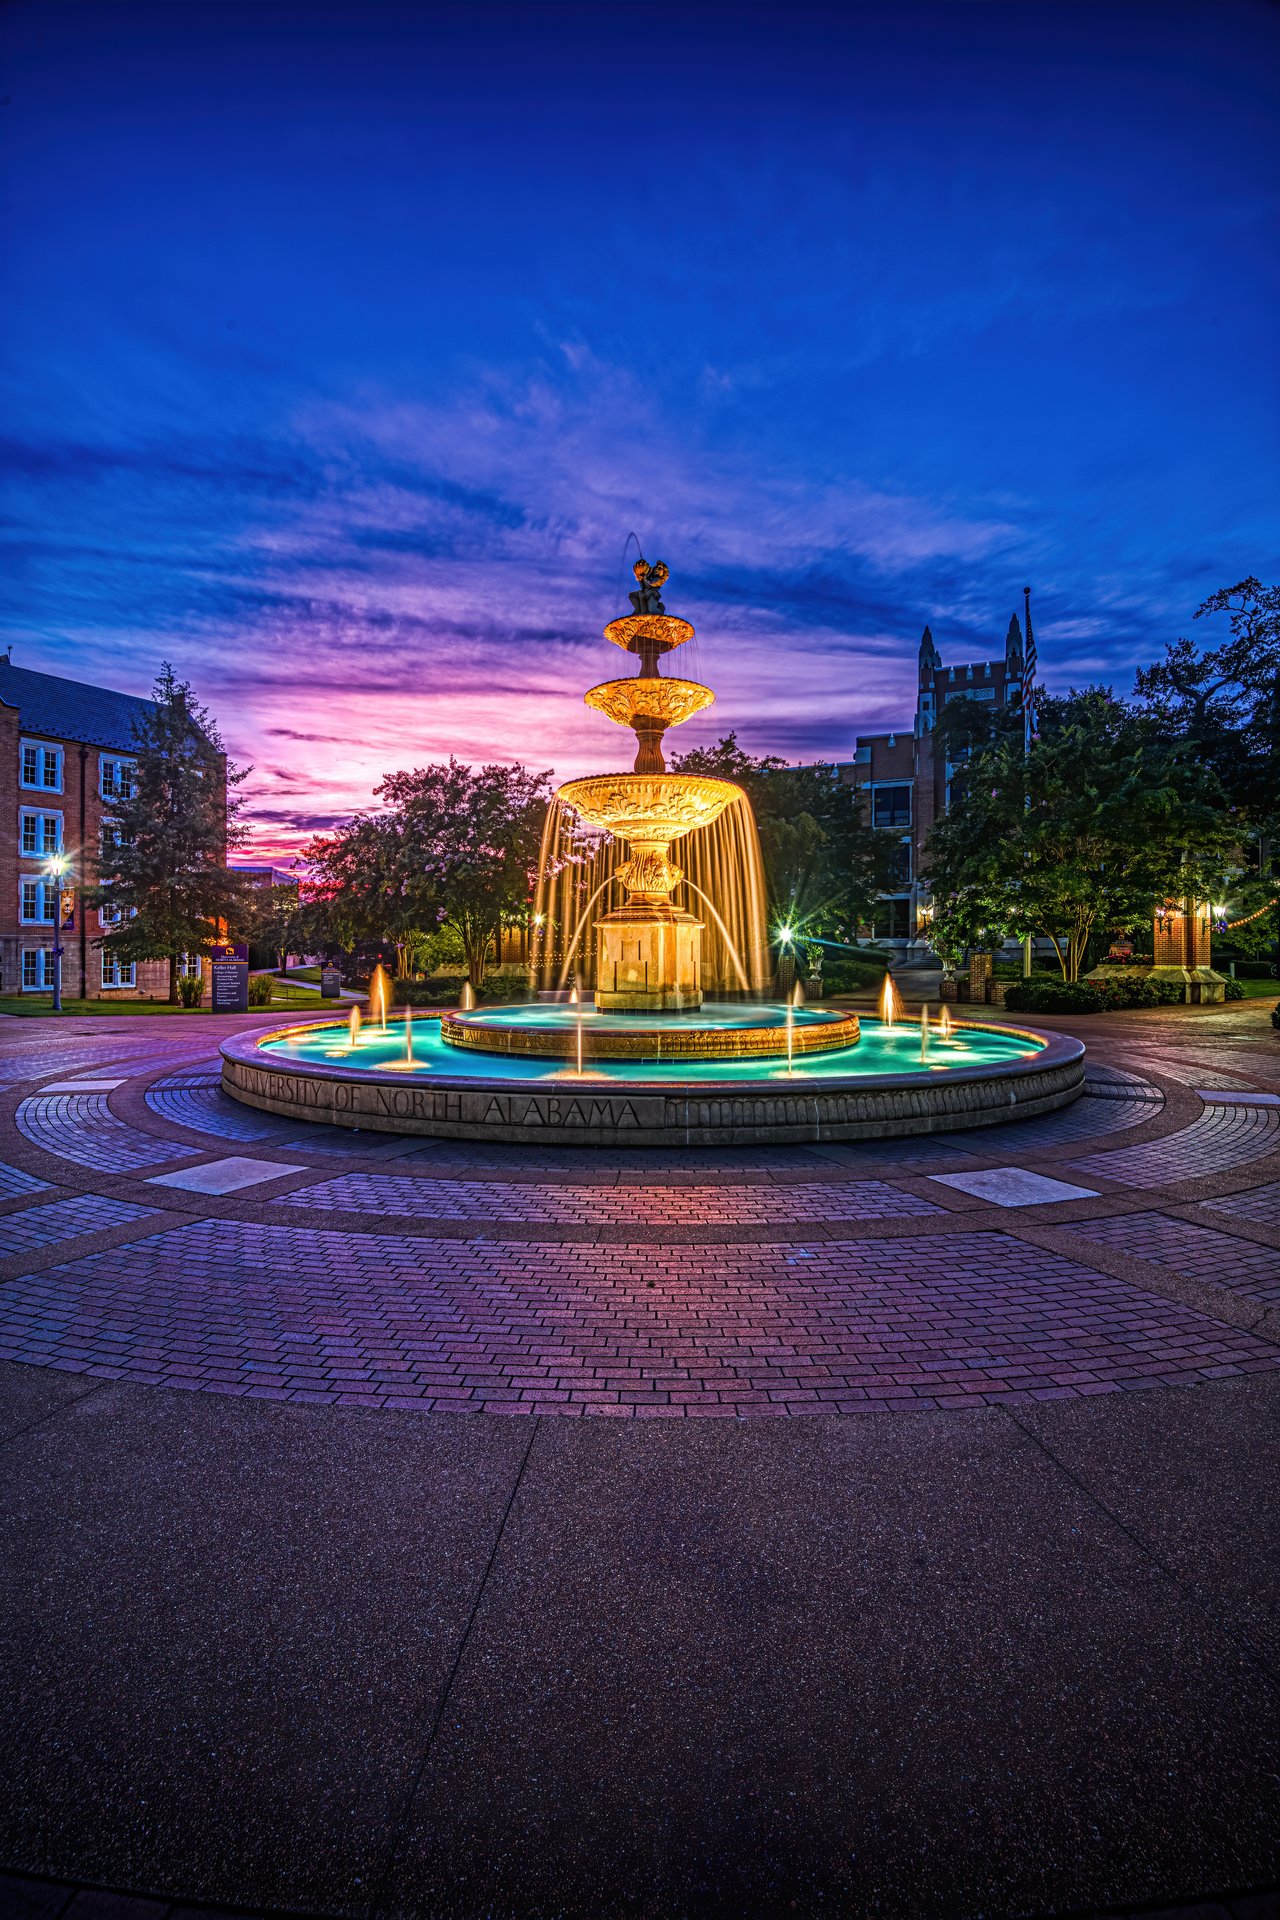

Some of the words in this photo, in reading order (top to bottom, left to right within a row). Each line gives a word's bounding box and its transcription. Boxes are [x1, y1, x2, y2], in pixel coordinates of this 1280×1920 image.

[239, 1067, 323, 1105] UNIVERSITY
[334, 1084, 361, 1111] OF
[375, 1088, 463, 1120] NORTH
[483, 1096, 641, 1126] ALABAMA
